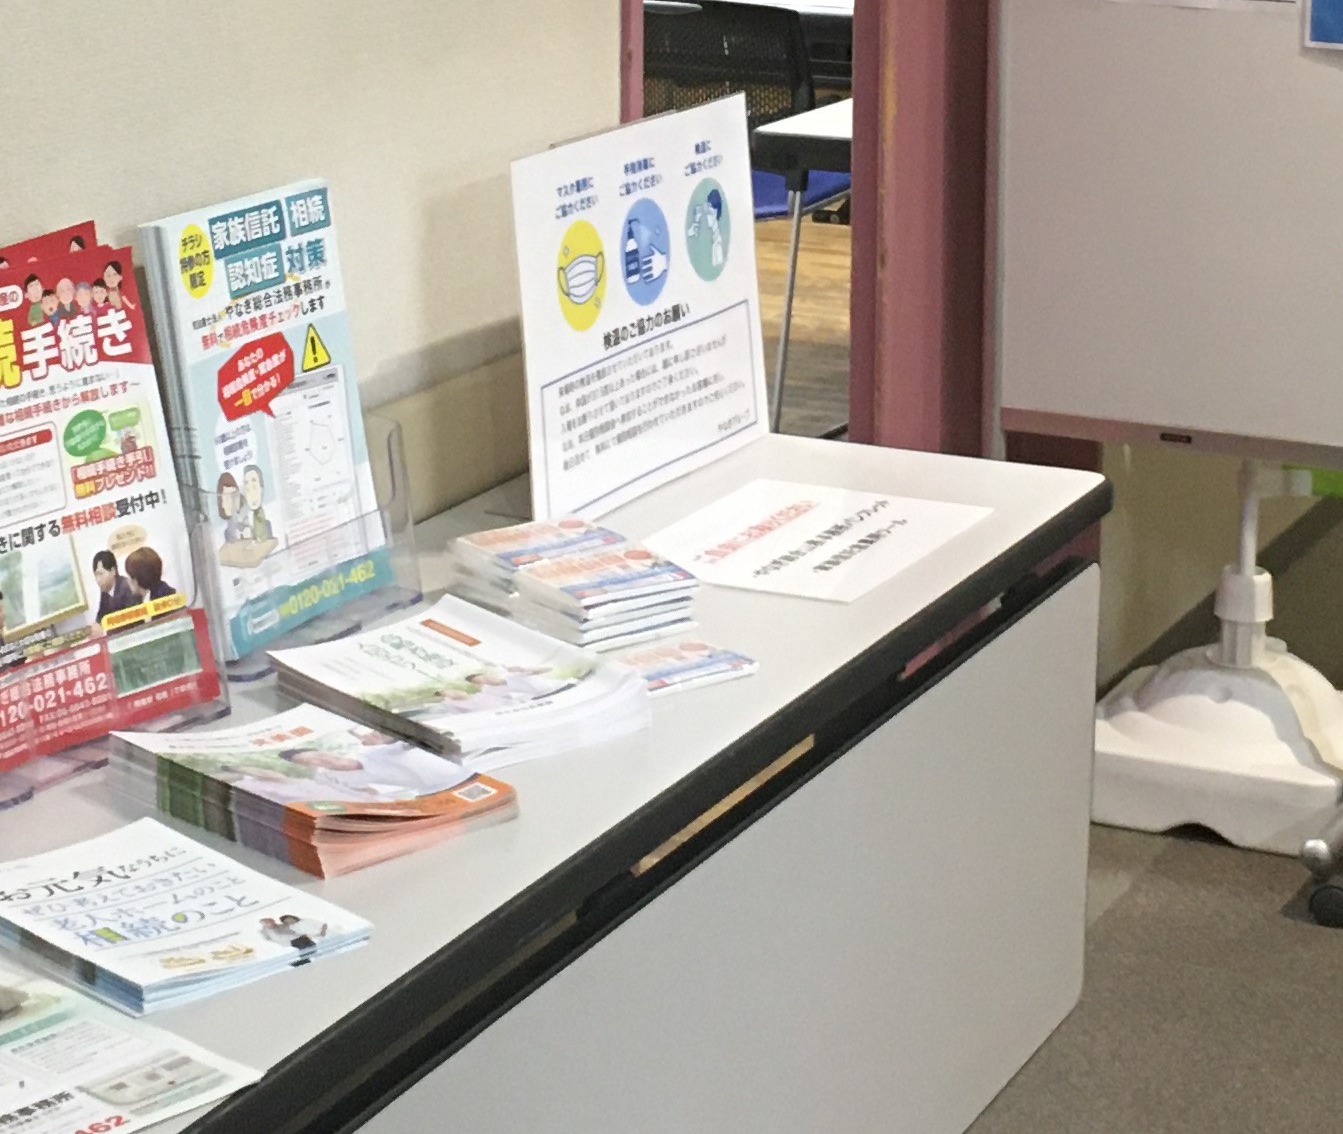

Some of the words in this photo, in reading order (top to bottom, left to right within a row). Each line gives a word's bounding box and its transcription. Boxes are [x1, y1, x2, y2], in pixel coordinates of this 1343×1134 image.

[212, 206, 281, 251] 家族信託
[290, 194, 326, 229] 相続
[229, 251, 281, 290] 認知症
[285, 237, 327, 274] 対策
[74, 894, 262, 948] 相続のこと
